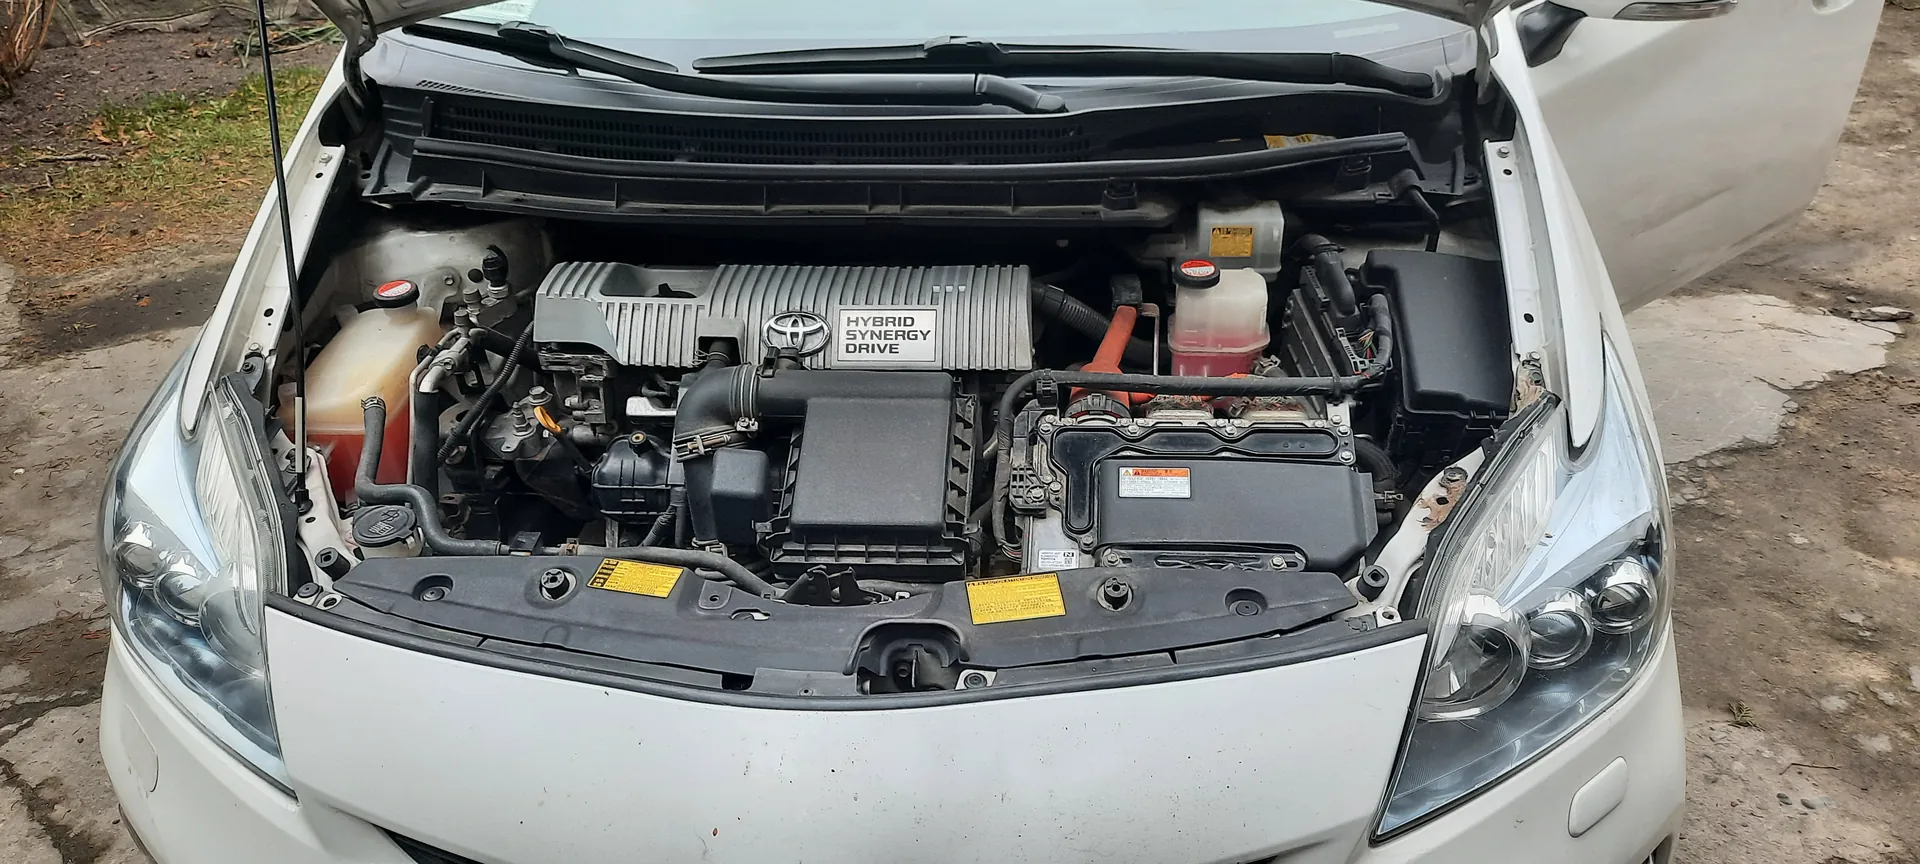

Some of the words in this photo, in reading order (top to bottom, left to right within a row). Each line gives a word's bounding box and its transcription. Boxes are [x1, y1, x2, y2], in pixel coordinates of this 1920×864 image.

[846, 316, 915, 327] HYBRID
[845, 329, 932, 341] SYNERGY
[845, 343, 900, 354] DRIVE
